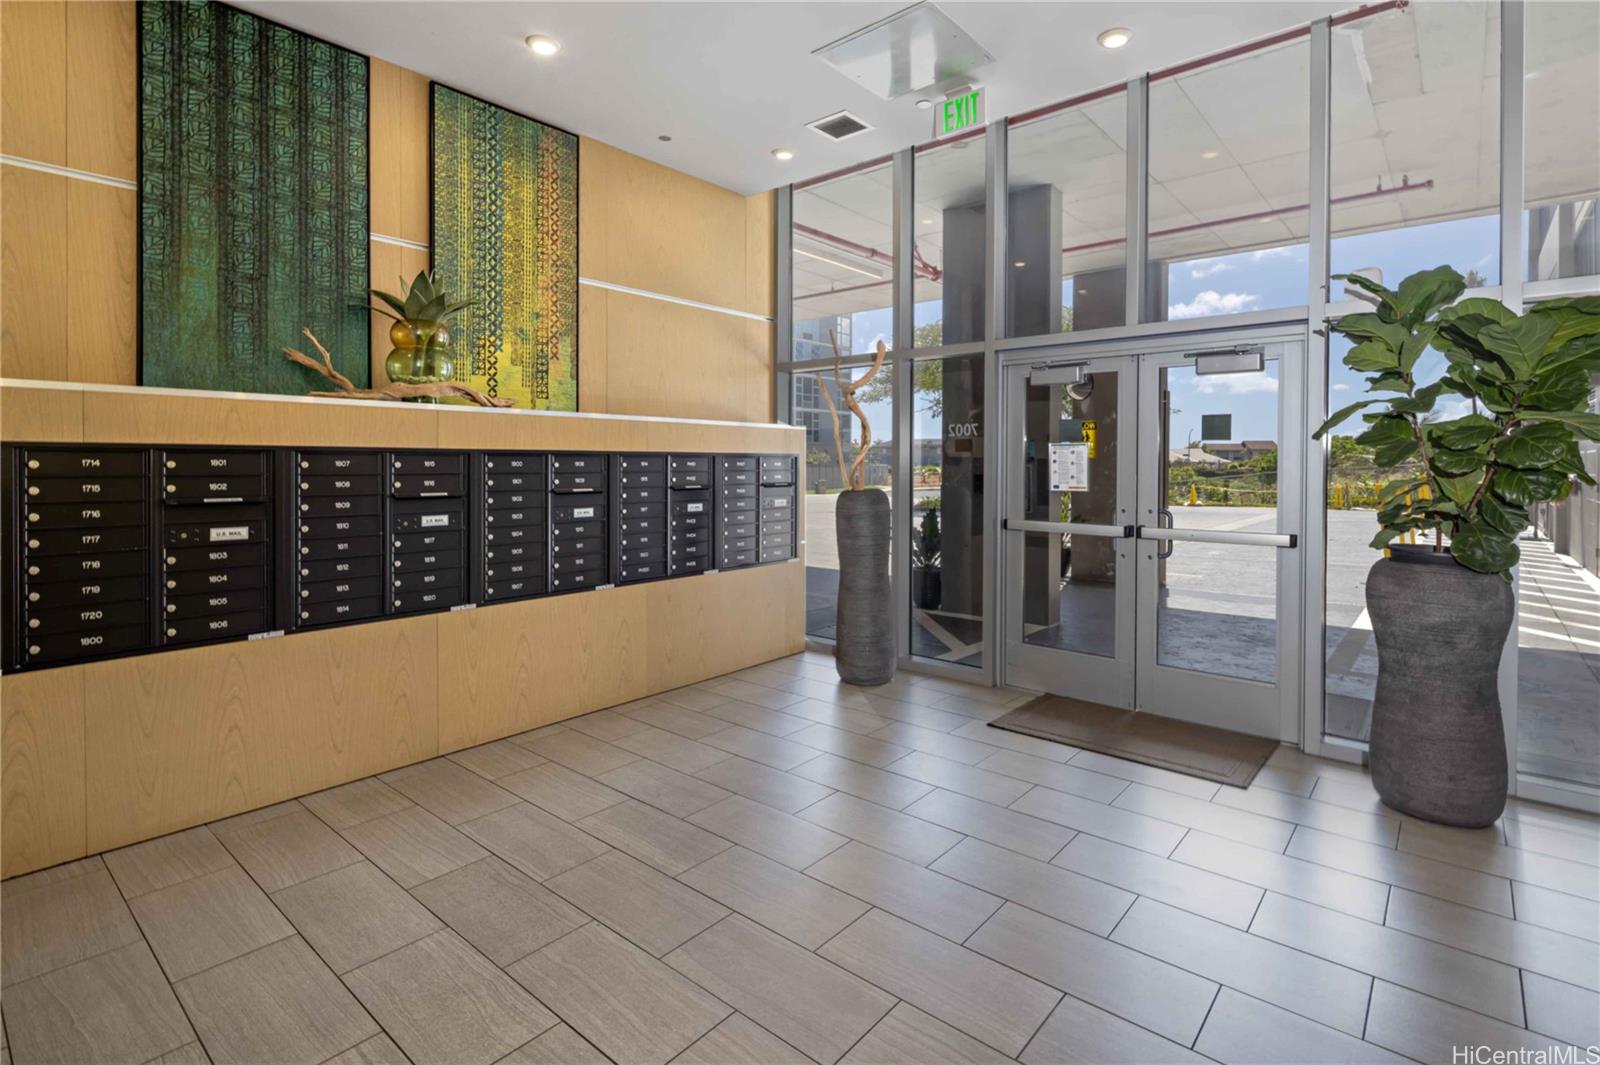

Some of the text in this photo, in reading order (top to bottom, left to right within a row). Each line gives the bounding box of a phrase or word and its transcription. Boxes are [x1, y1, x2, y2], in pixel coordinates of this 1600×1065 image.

[944, 90, 980, 133] EXIT
[82, 459, 101, 468] 1714
[210, 458, 227, 468] 1801
[82, 483, 101, 493] 1715
[209, 482, 228, 491] 1802
[82, 509, 101, 519] 1716
[82, 534, 101, 544] 1717
[209, 551, 228, 560] 1803
[82, 560, 101, 569] 1718
[209, 574, 228, 584] 1804
[82, 585, 101, 594] 1719
[209, 596, 228, 606] 1805
[81, 610, 103, 620] 1720
[209, 619, 228, 629] 1806
[81, 635, 104, 646] 1800
